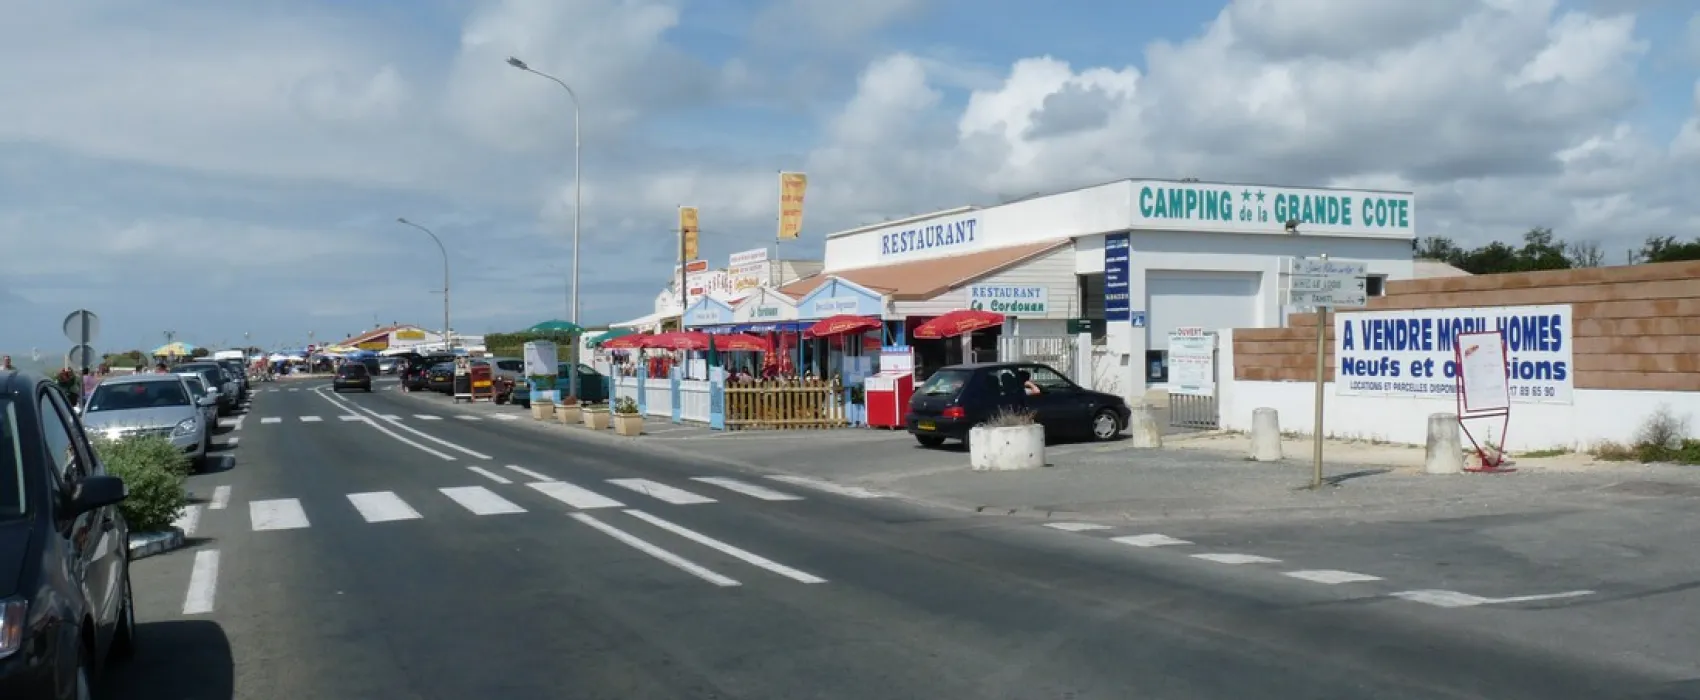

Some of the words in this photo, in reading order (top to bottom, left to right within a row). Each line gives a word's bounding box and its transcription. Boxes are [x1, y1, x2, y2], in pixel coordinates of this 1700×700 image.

[1139, 185, 1233, 221] CAMPING
[1239, 204, 1252, 222] de
[1257, 204, 1268, 222] la
[1274, 193, 1352, 225] GRANDE
[1362, 198, 1409, 228] COTE
[882, 218, 977, 255] RESTAURANT
[971, 287, 1041, 298] RESTAURANT
[991, 299, 1044, 312] Cordouan
[1178, 328, 1202, 336] OUVERT
[1342, 320, 1354, 351] A
[1361, 319, 1432, 351] VENDRE
[1496, 314, 1562, 352] HOMES
[1341, 356, 1401, 377] Neufs
[1410, 357, 1434, 377] et
[1444, 357, 1567, 381] oions
[1350, 380, 1382, 391] LOCATIONS
[1384, 382, 1392, 391] ET
[1393, 382, 1427, 392] PARCELLES
